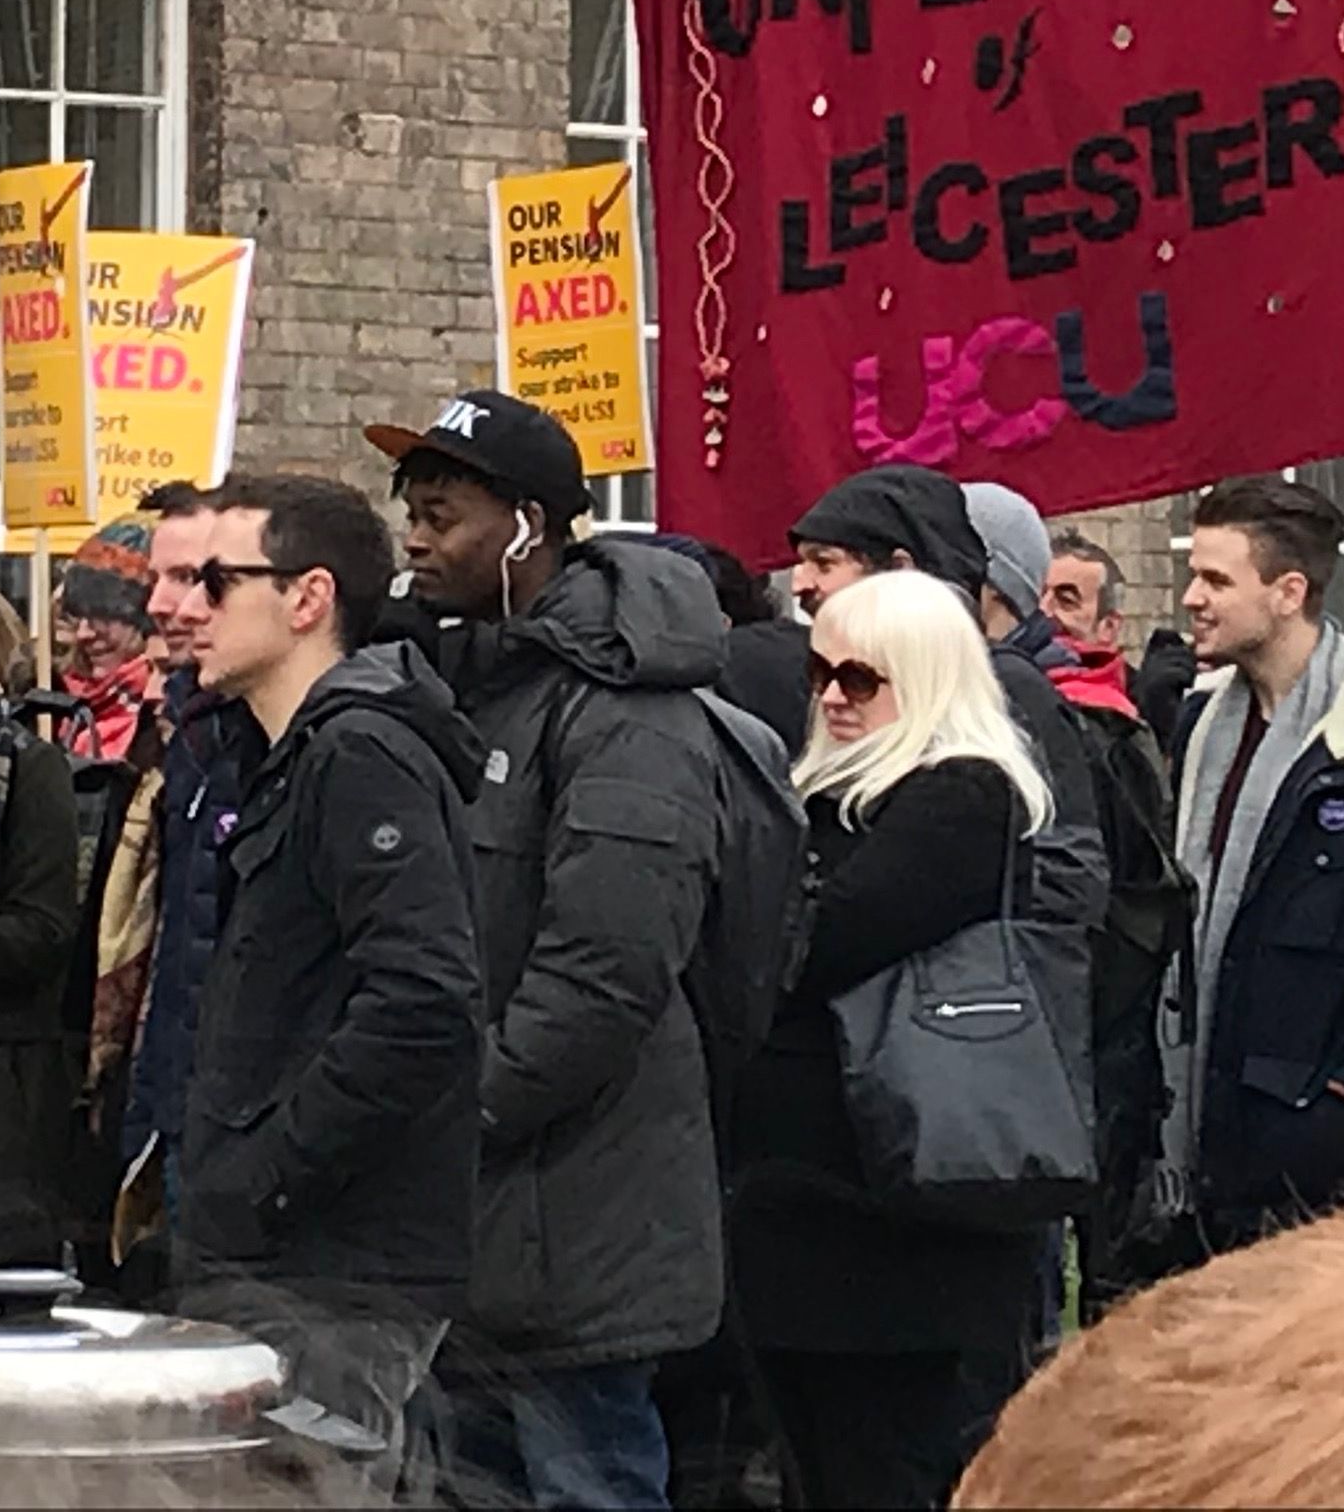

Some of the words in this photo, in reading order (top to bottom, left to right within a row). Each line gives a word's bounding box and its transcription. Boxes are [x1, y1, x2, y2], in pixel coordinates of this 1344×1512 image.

[975, 6, 1042, 110] of
[508, 201, 562, 232] OUR
[509, 231, 621, 269] PENSION
[87, 298, 207, 333] NSION
[514, 274, 629, 328] AXED.
[92, 343, 204, 393] XED.
[517, 343, 588, 370] Support
[147, 447, 174, 468] to
